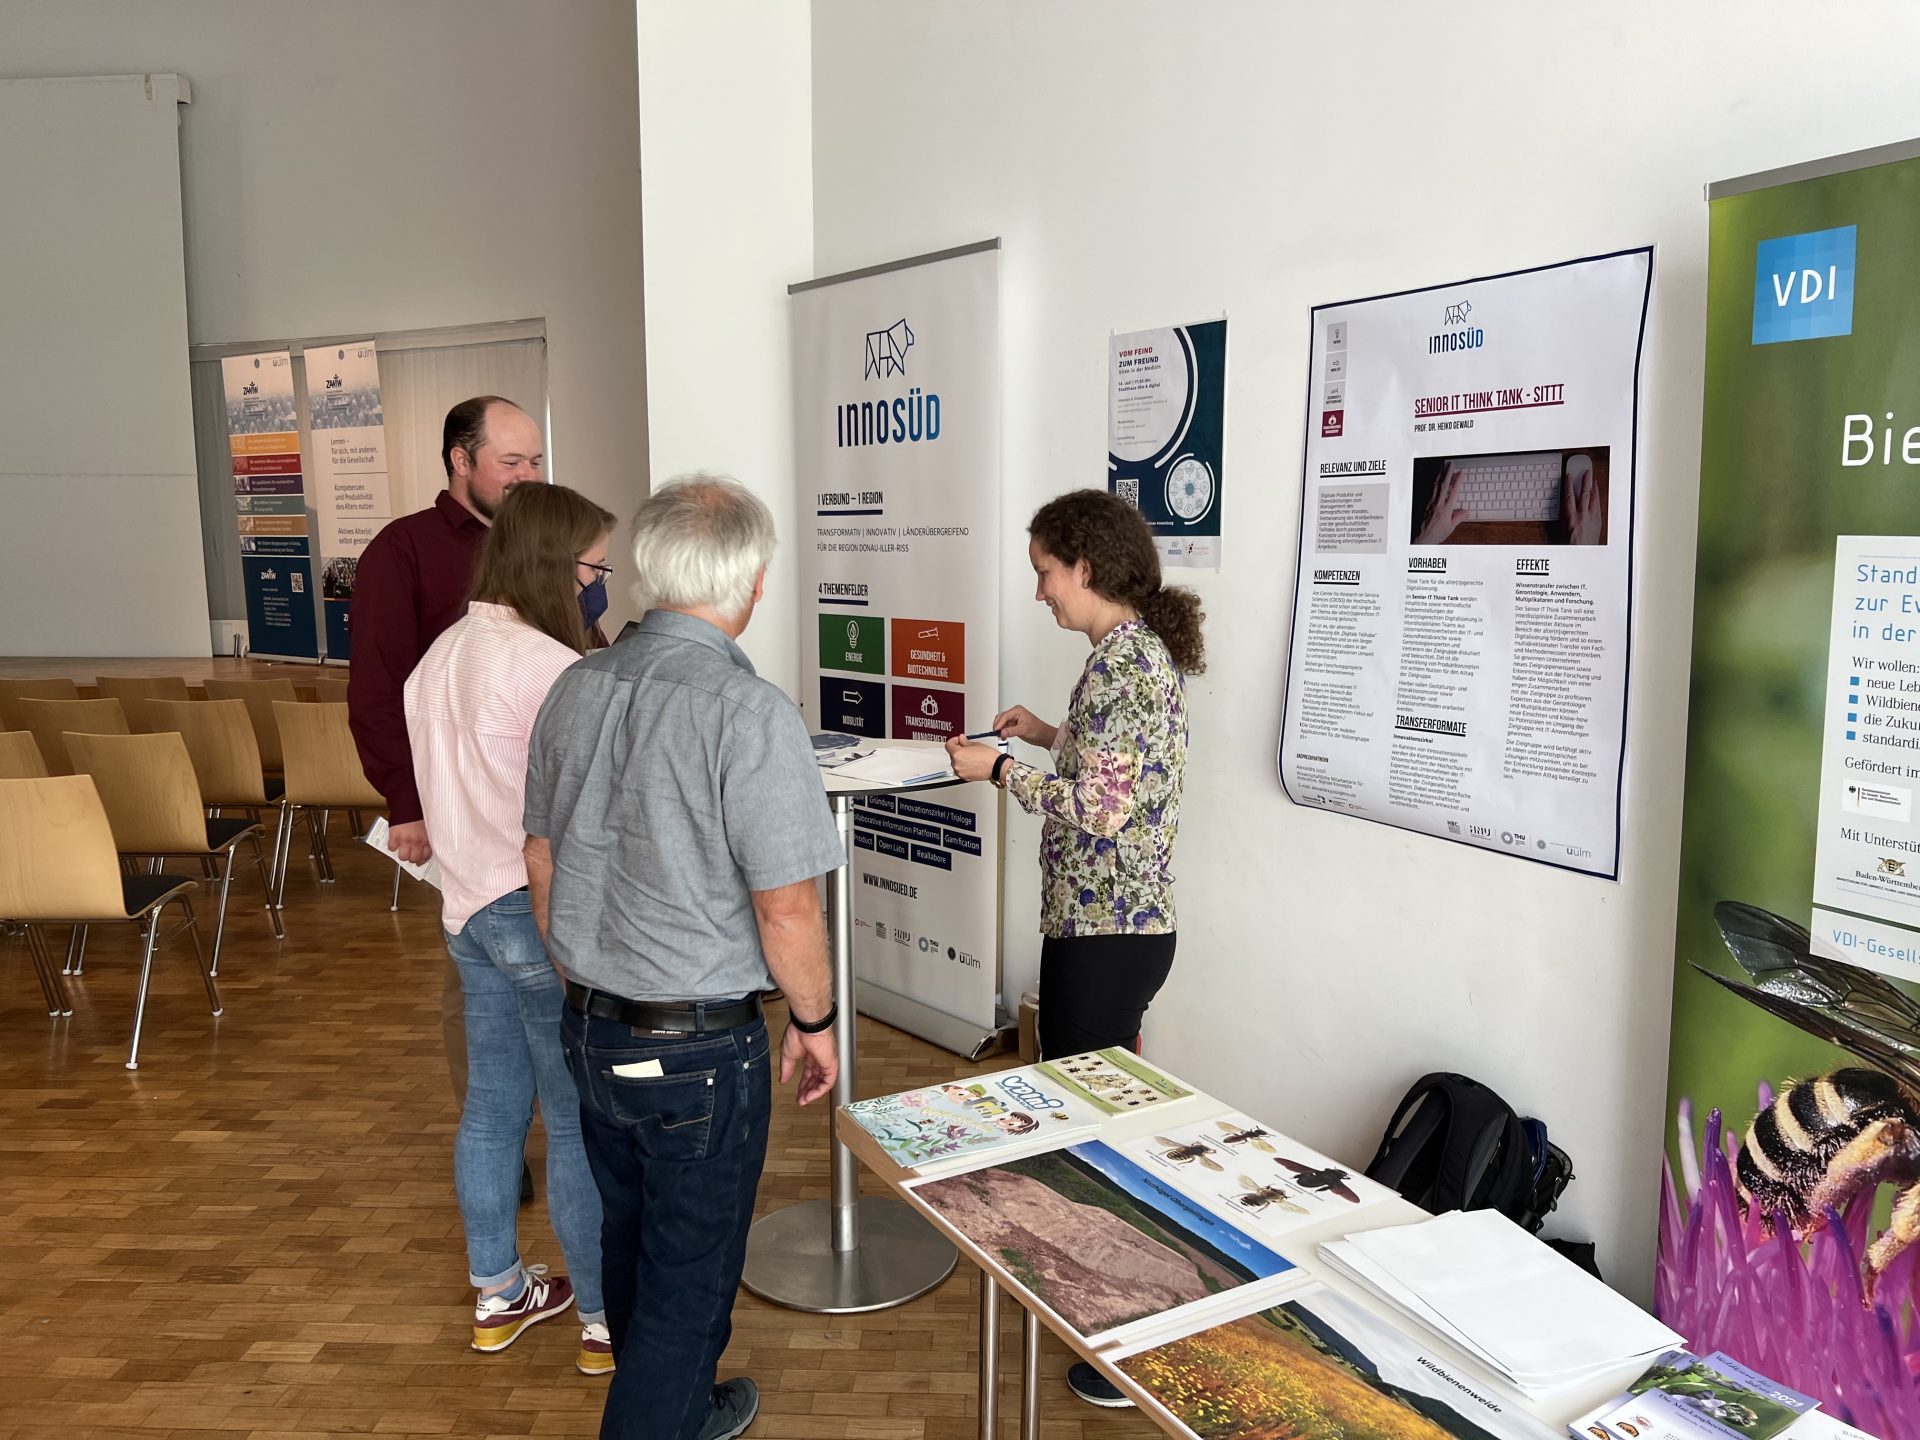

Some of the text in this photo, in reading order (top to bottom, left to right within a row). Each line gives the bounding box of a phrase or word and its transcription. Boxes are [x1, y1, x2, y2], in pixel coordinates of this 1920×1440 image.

[1773, 266, 1836, 307] VDI
[1135, 347, 1152, 355] FEIND
[1134, 356, 1158, 365] FREUND
[1415, 396, 1448, 414] SENIOR
[1451, 395, 1461, 411] IT
[1463, 391, 1493, 410] THINK
[1496, 388, 1523, 406] TANK
[1534, 383, 1564, 403] SITTT
[1414, 423, 1426, 432] PROF.
[1438, 421, 1452, 431] HEIKO
[1454, 420, 1473, 430] GEWALD
[1320, 460, 1386, 473] RELEVANZ UND ZIELE
[335, 485, 364, 493] Kompetenzen
[822, 493, 850, 505] VERBUND
[858, 493, 861, 504] 1
[862, 492, 883, 504] REGION
[817, 525, 969, 537] TRANSFORMATIV INNOVATIV LÄNDERÜBERGREIFEND
[829, 544, 837, 552] DIE
[839, 544, 858, 552] REGION
[859, 544, 909, 552] DONAU-ILLER-RISS
[1409, 558, 1446, 568] VORHABEN
[1516, 559, 1549, 570] EFFEKTE
[1314, 570, 1360, 581] KOMPETENZEN
[819, 583, 868, 596] 4 THEMENFELDER
[1855, 597, 1888, 611] zur
[1852, 621, 1916, 642] in der
[846, 652, 863, 663] ENERGIE
[911, 649, 946, 662] GESUNDHEIT &
[908, 664, 948, 677] BIOTECHNOLOGIE
[1852, 656, 1919, 673] Wir wollen:
[1867, 678, 1895, 690] neue
[842, 714, 864, 728] MOBILITÄT
[905, 715, 954, 732] TRANSFORMATIONS-
[1396, 715, 1467, 733] TRANSFERFORMATE
[1864, 713, 1882, 726] die
[912, 730, 947, 742] MANAGEMENT
[1394, 734, 1433, 743] Innovationszirkel
[1845, 756, 1902, 776] Gefördert
[869, 796, 894, 809] Gründung
[900, 802, 946, 819] Innovationszirkel
[951, 813, 972, 825] Trialoge
[883, 821, 912, 833] Information
[913, 827, 939, 840] Platforms
[1841, 828, 1859, 842] Mit
[879, 840, 905, 853] Open Labs
[945, 834, 979, 850] Gamification
[917, 849, 946, 863] Reallabore
[863, 872, 918, 898] WWW.INNOSUED.DE
[528, 1284, 549, 1310] N
[1417, 1357, 1502, 1413] Wildbienenweide
[1770, 1391, 1803, 1408] 2021
